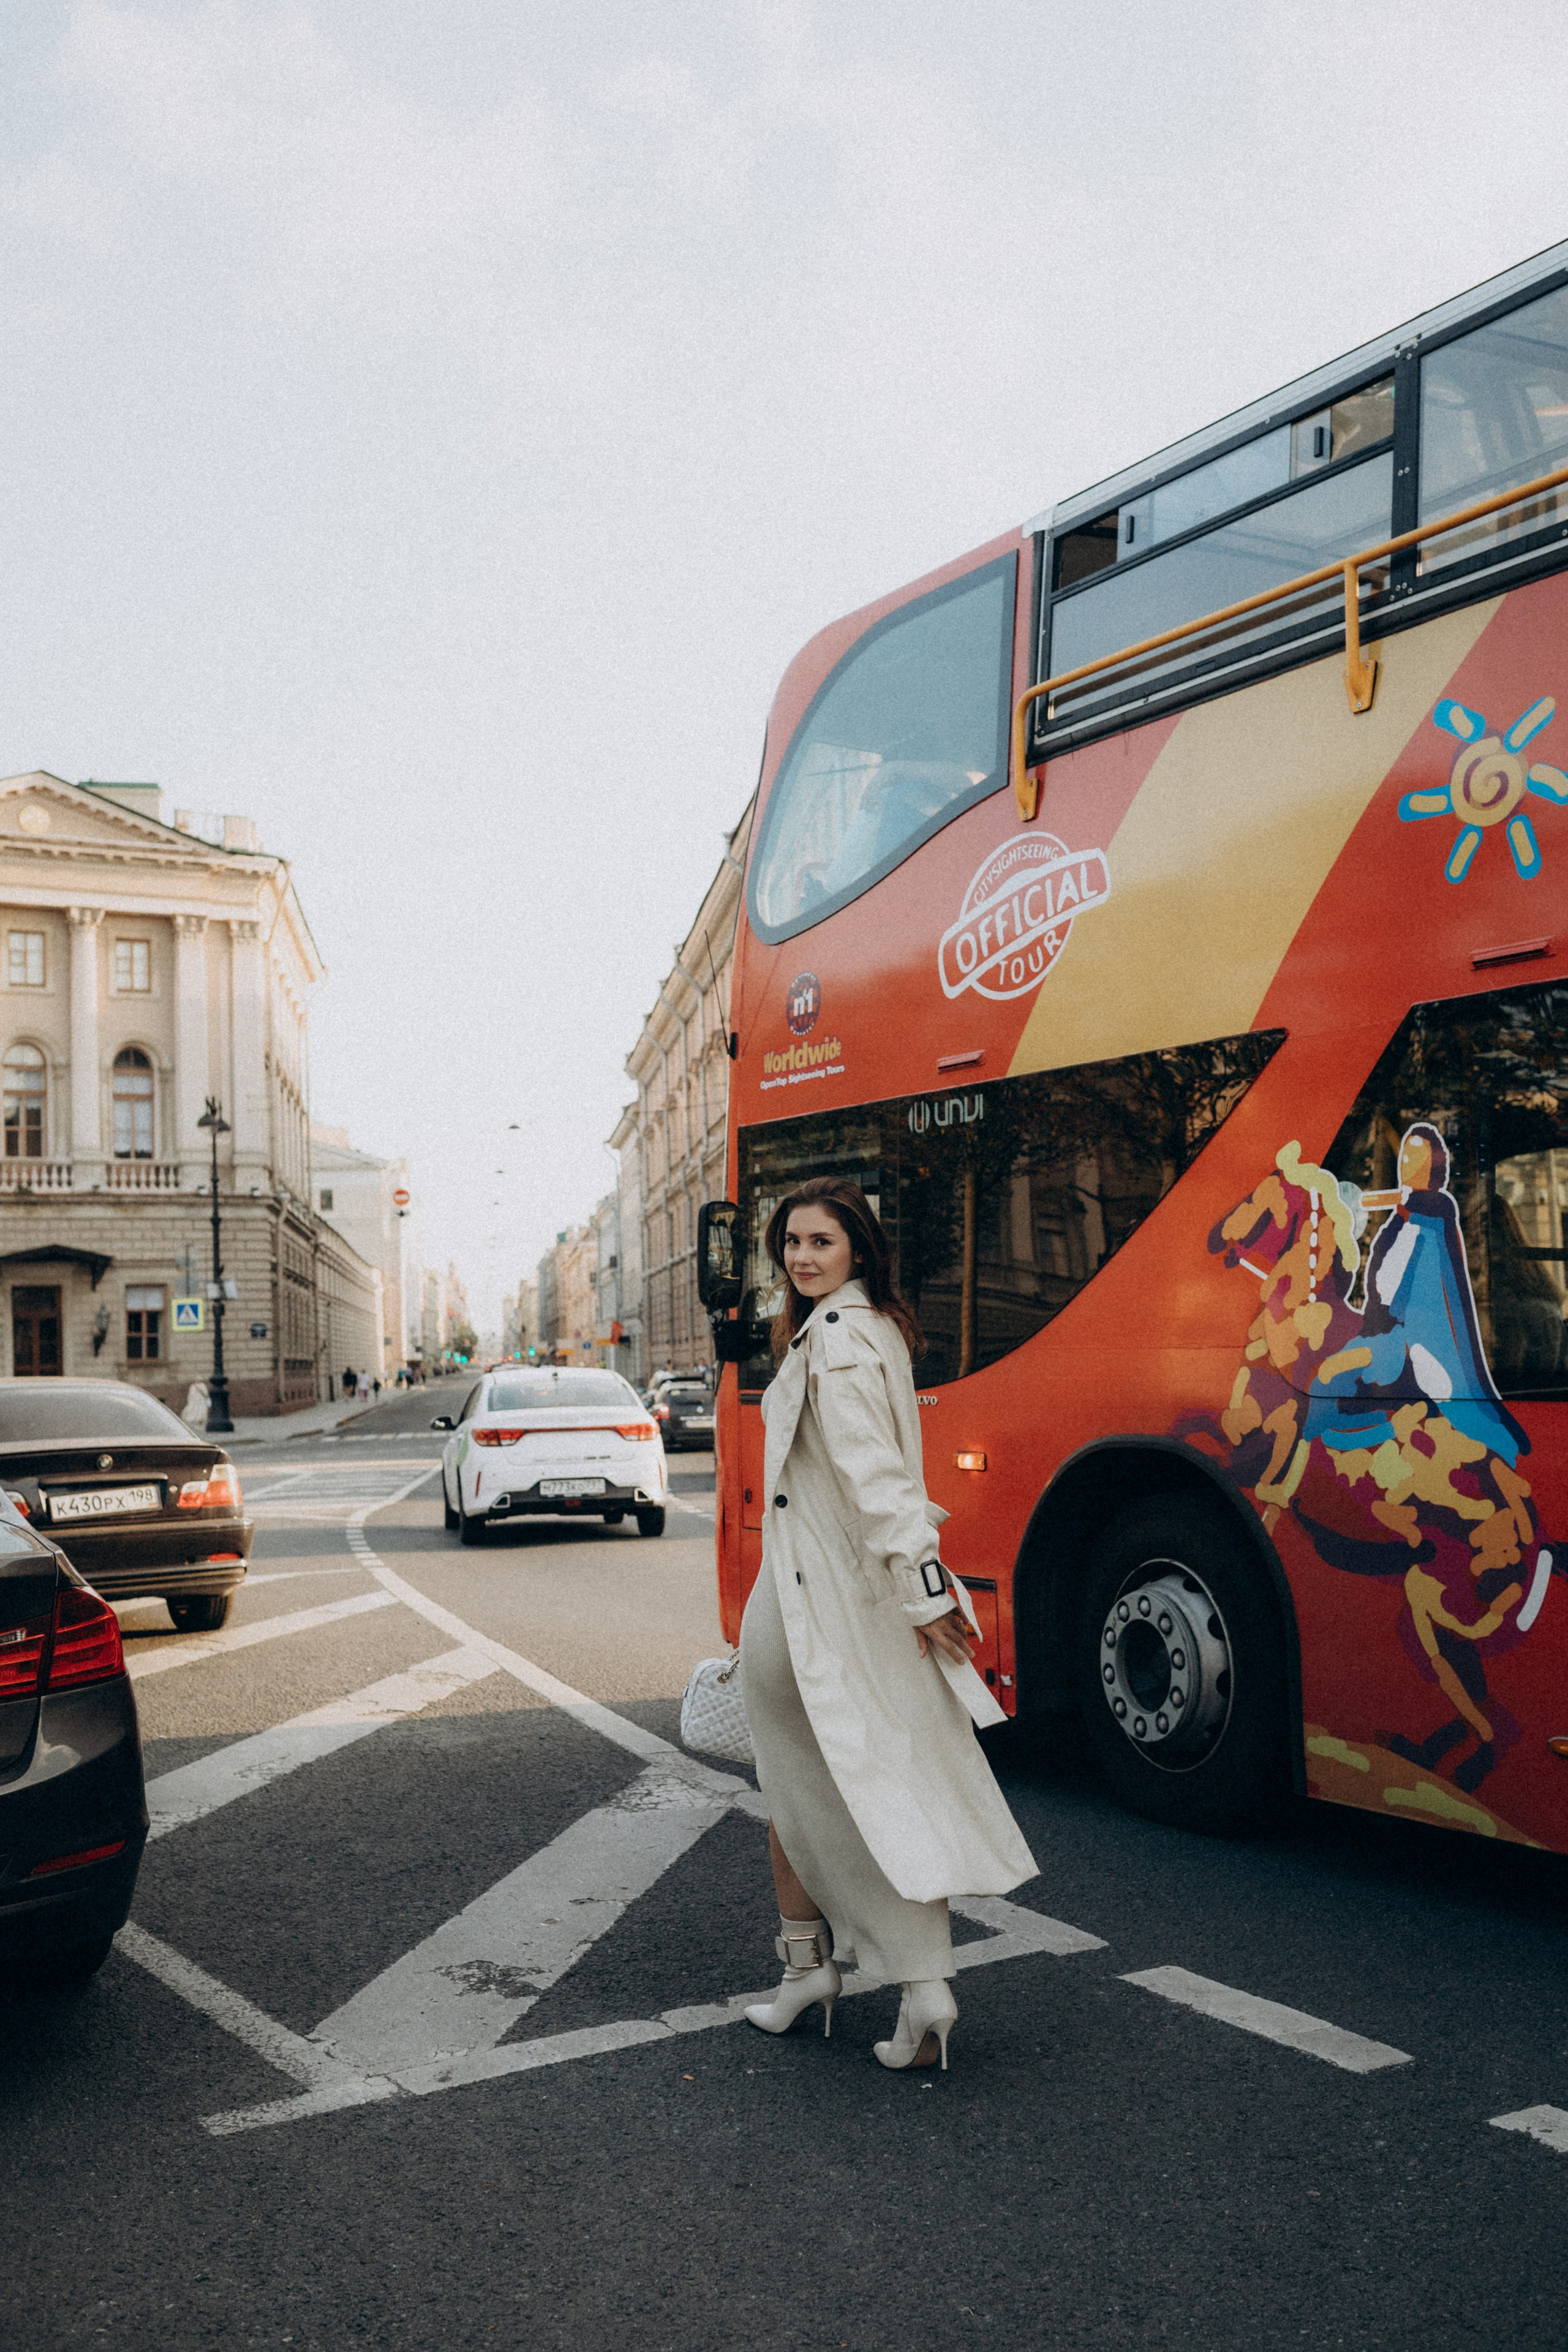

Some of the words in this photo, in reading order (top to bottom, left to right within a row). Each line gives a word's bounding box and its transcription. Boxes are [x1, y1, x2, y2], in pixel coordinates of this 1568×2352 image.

[956, 863, 1098, 973] OFFICIAL
[998, 930, 1061, 985] TOUR
[827, 1065, 845, 1076] Tours
[917, 1396, 938, 1406] LVO
[129, 1490, 153, 1502] 198
